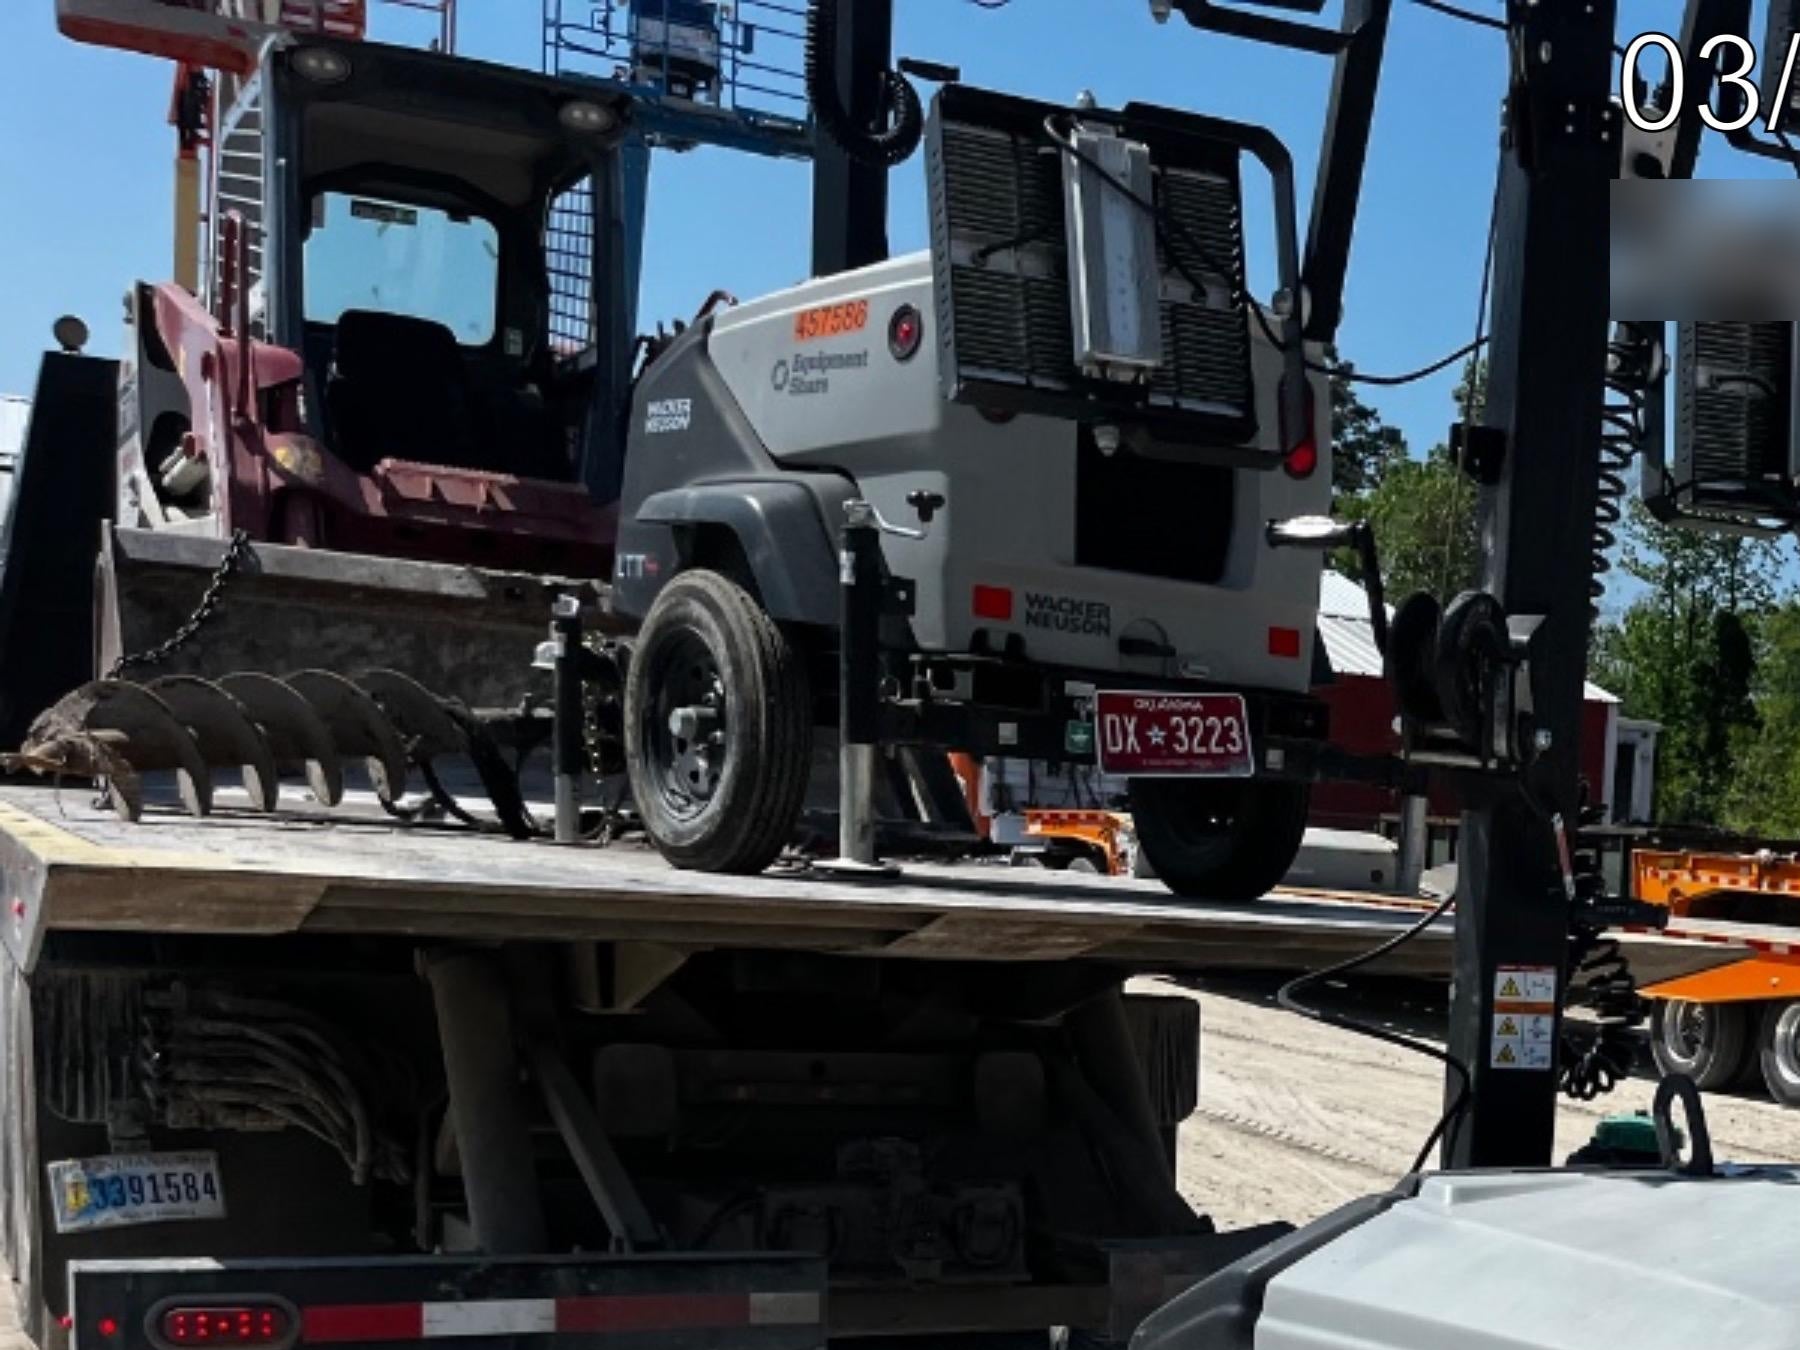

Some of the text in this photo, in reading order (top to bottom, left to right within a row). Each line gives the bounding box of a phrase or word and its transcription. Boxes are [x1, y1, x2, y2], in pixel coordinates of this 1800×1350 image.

[792, 349, 868, 376] Equipment
[1025, 593, 1109, 619] WACKER
[1025, 609, 1110, 636] NEUSON
[1105, 713, 1244, 755] DX 3223
